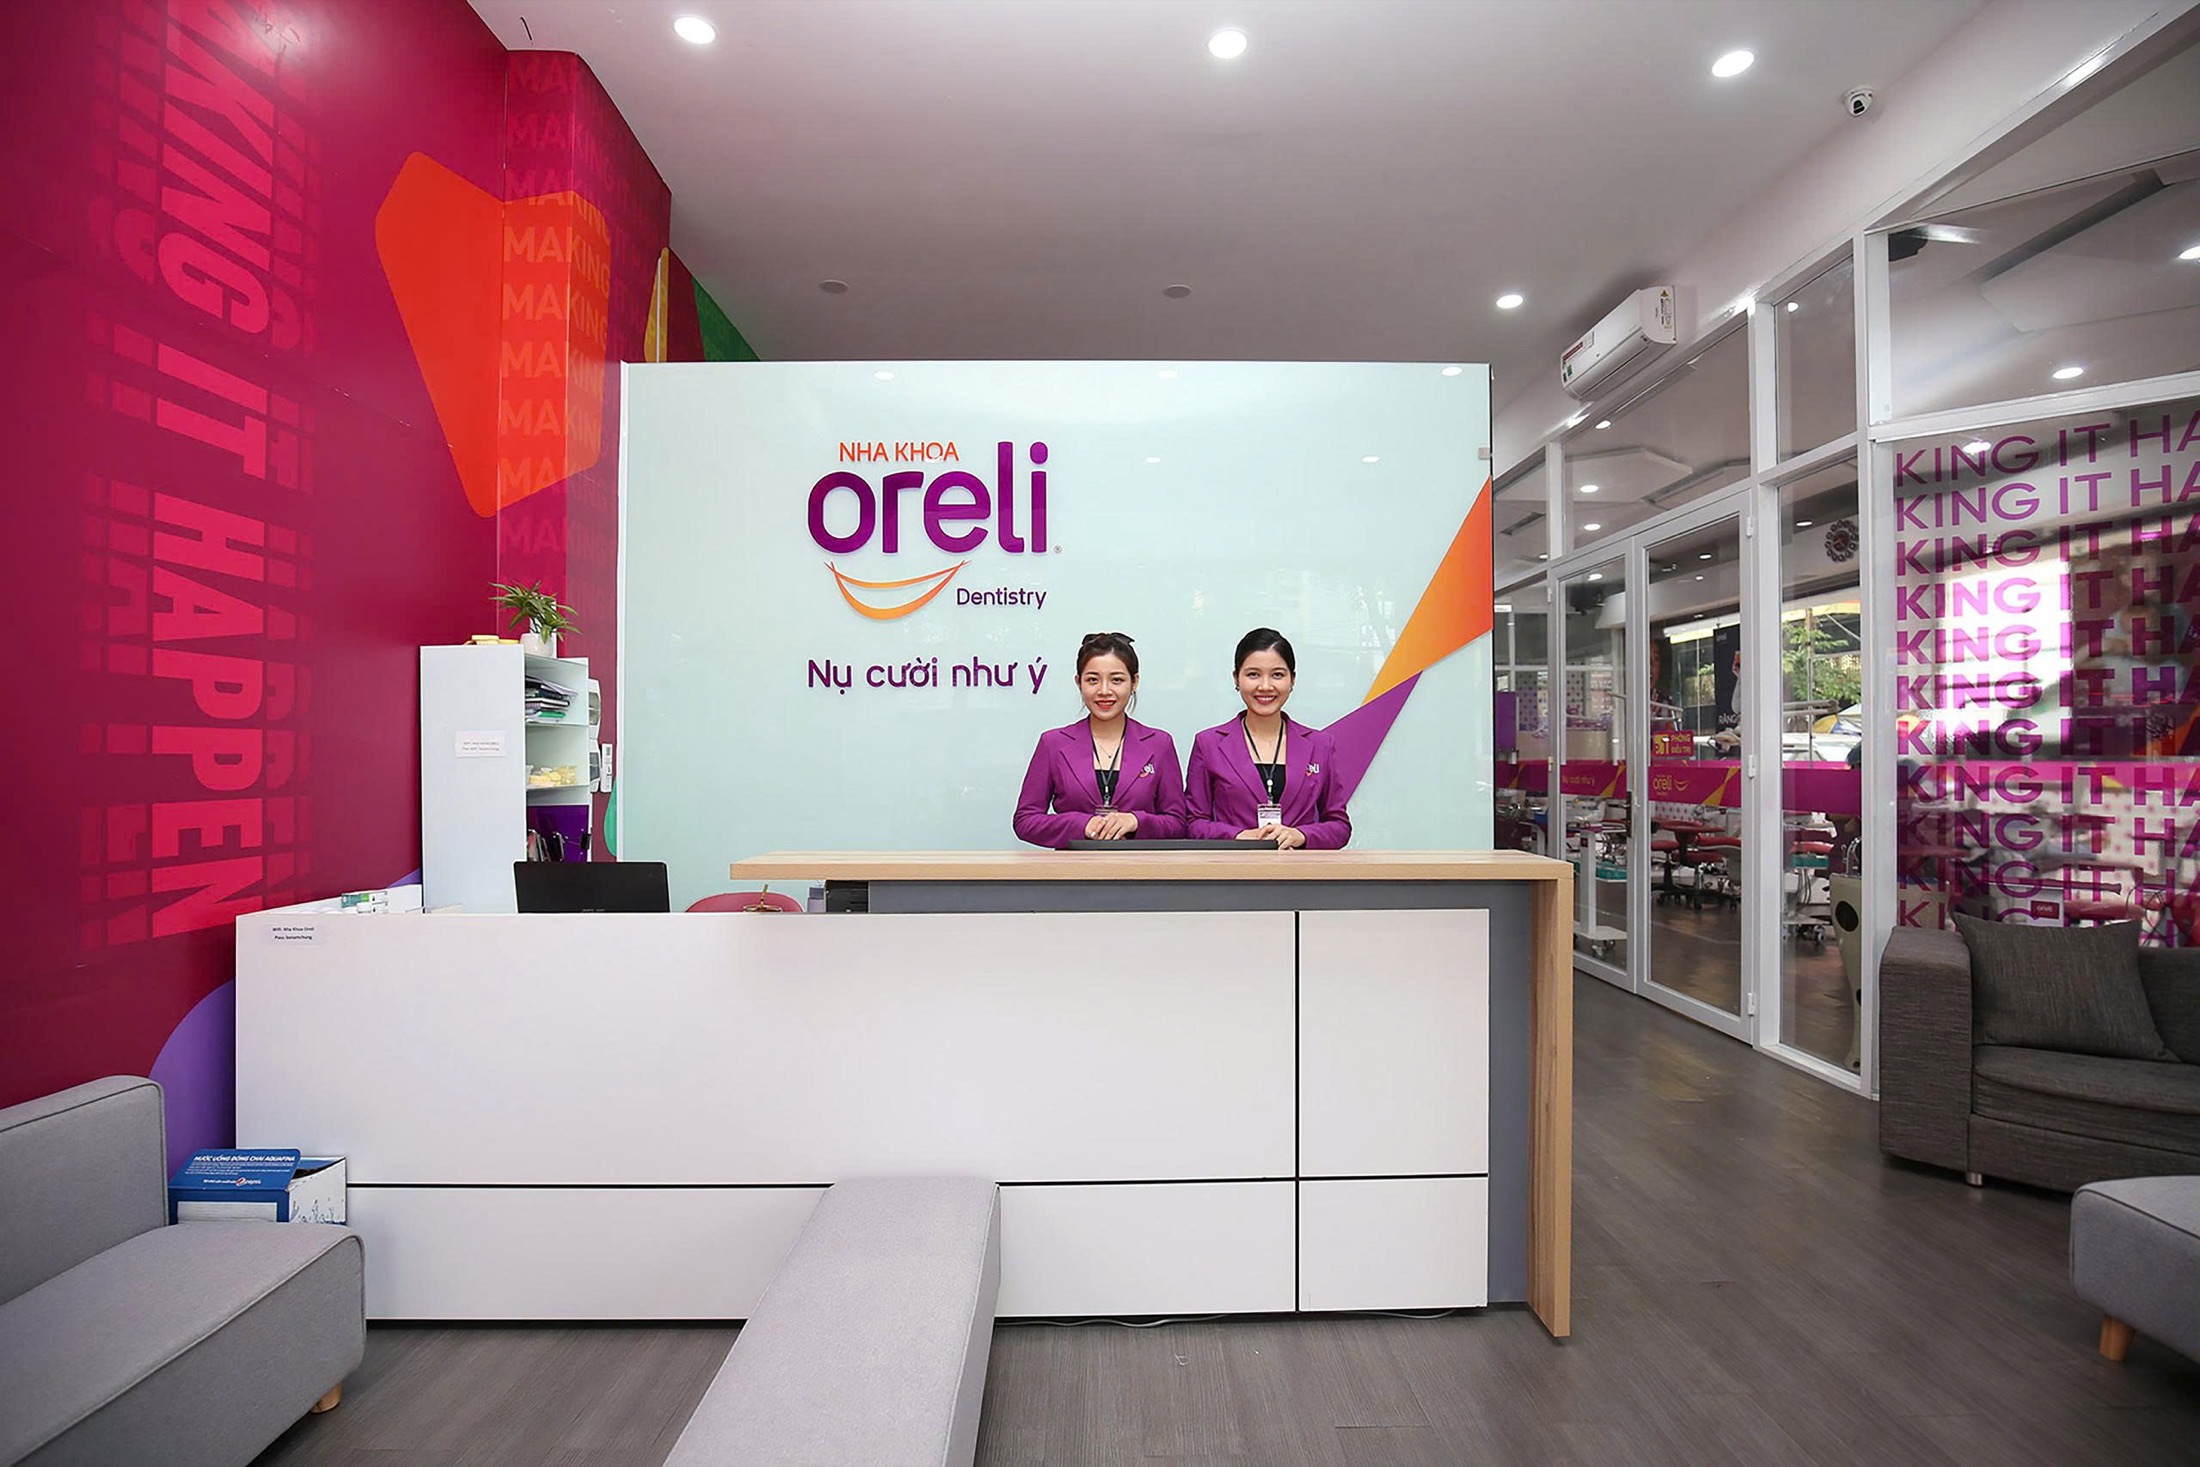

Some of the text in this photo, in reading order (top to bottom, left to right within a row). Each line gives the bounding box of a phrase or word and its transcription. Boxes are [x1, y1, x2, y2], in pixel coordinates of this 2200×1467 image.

[503, 225, 610, 297] MAKING
[502, 283, 608, 350] MAKING
[156, 343, 268, 480] IT
[839, 441, 960, 462] NHA KHOA
[1896, 435, 2039, 487] KING
[2059, 423, 2111, 466] IT
[807, 441, 1048, 553] oreli
[1896, 482, 2040, 531] KING
[2060, 472, 2111, 514] IT
[1897, 529, 2041, 576] KING
[2060, 521, 2112, 561] IT
[956, 586, 1047, 610] Dentistry
[1897, 577, 2041, 620] KING
[2060, 570, 2113, 610] IT
[1897, 624, 2042, 665] KING
[2060, 619, 2114, 658] IT
[808, 656, 1048, 695] Nụ cười như ý
[1897, 671, 2043, 710] KING
[2060, 668, 2115, 706] IT
[152, 491, 265, 939] HAPPEN
[1897, 718, 2043, 755] KING
[2060, 717, 2115, 755] IT
[1897, 765, 2043, 803] KING
[2061, 766, 2115, 804] IT
[1897, 811, 2043, 850] KING
[2062, 814, 2115, 853] IT
[1897, 855, 2043, 898] KING
[2063, 864, 2115, 902] IT
